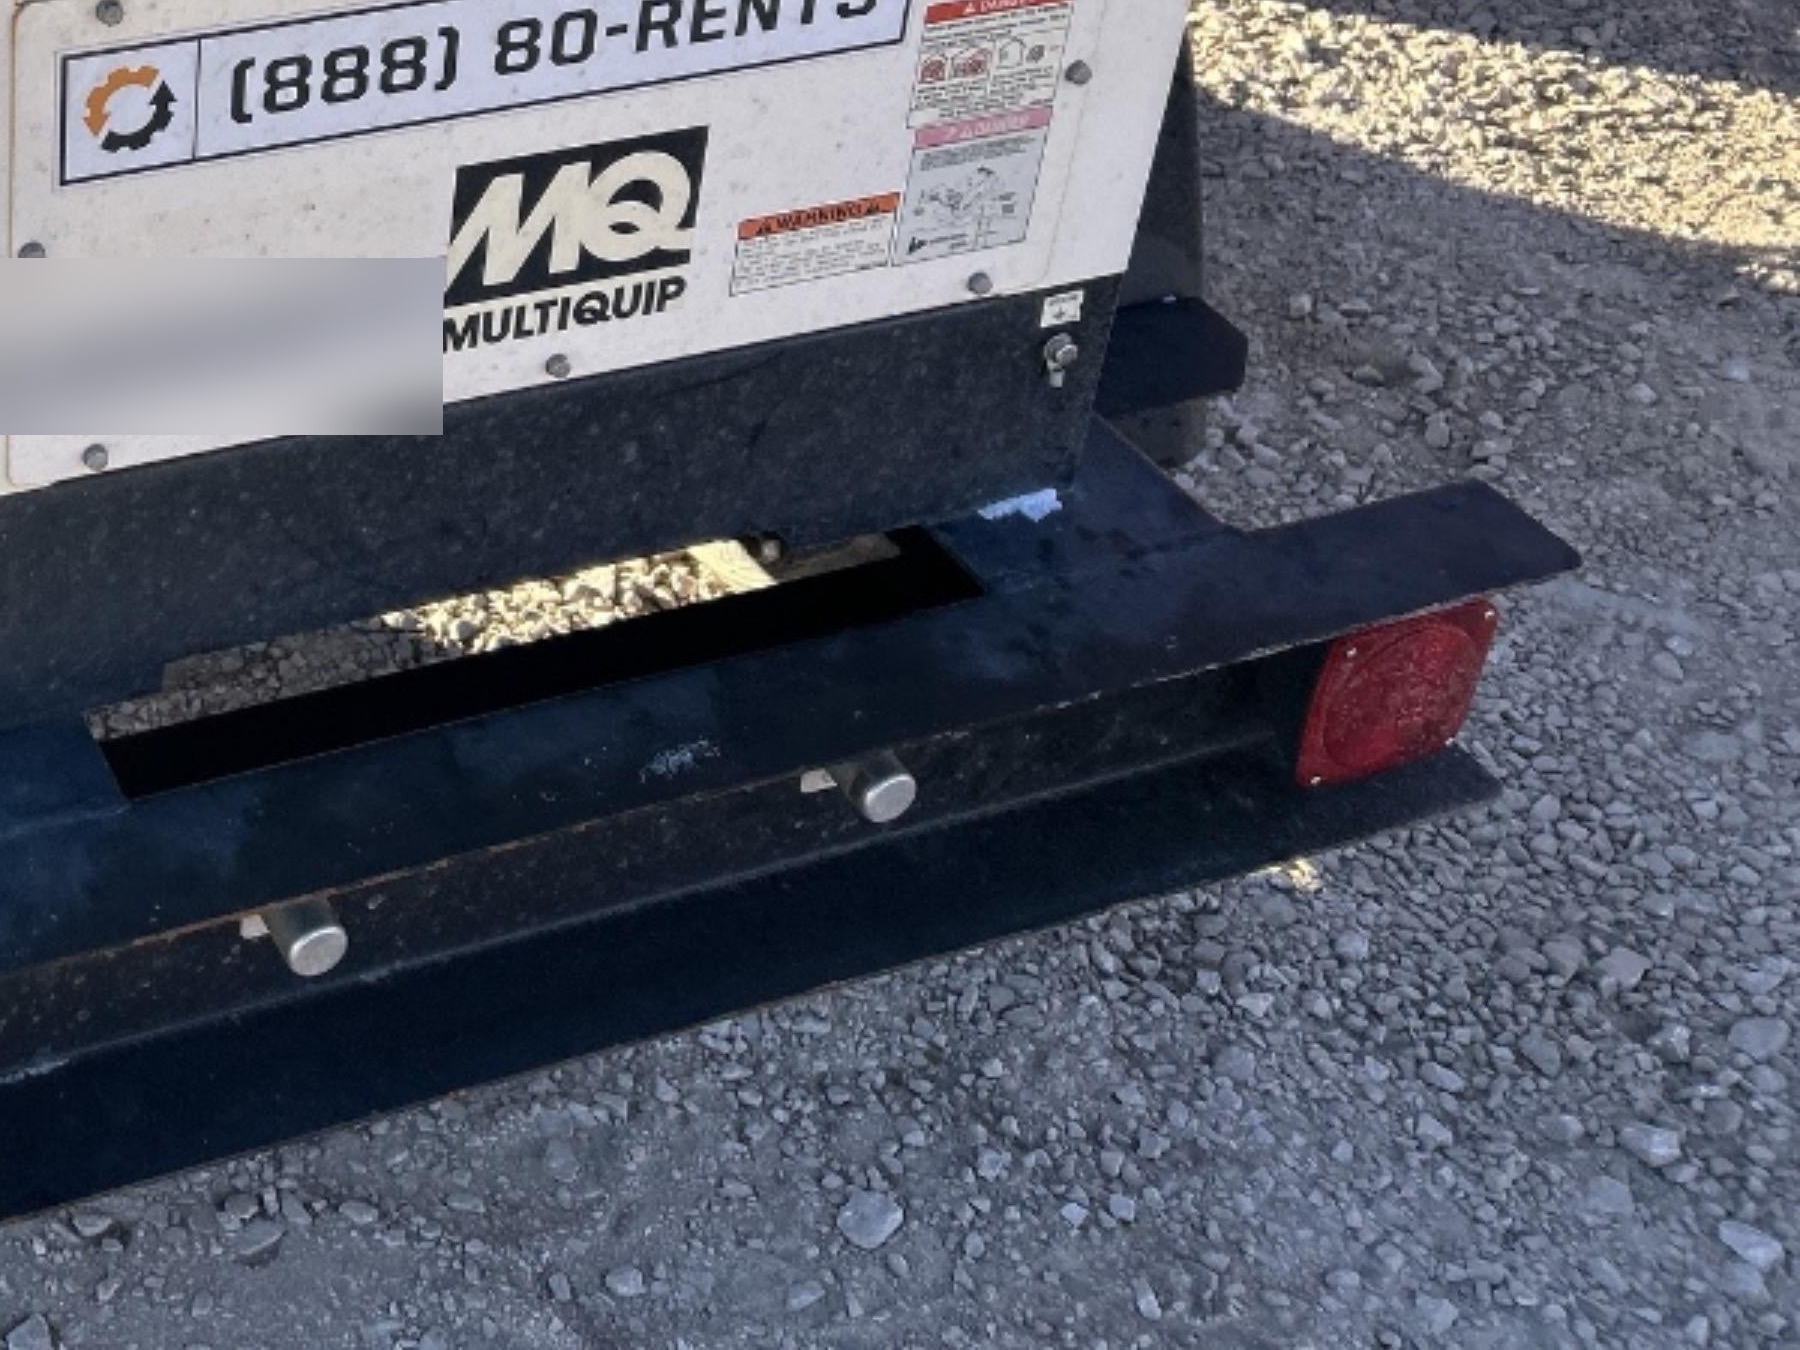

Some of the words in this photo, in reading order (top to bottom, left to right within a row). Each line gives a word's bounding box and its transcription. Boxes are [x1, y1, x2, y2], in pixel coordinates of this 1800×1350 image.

[229, 27, 460, 125] (888)
[444, 147, 699, 290] MQ
[443, 275, 688, 354] MULTIQUIP
